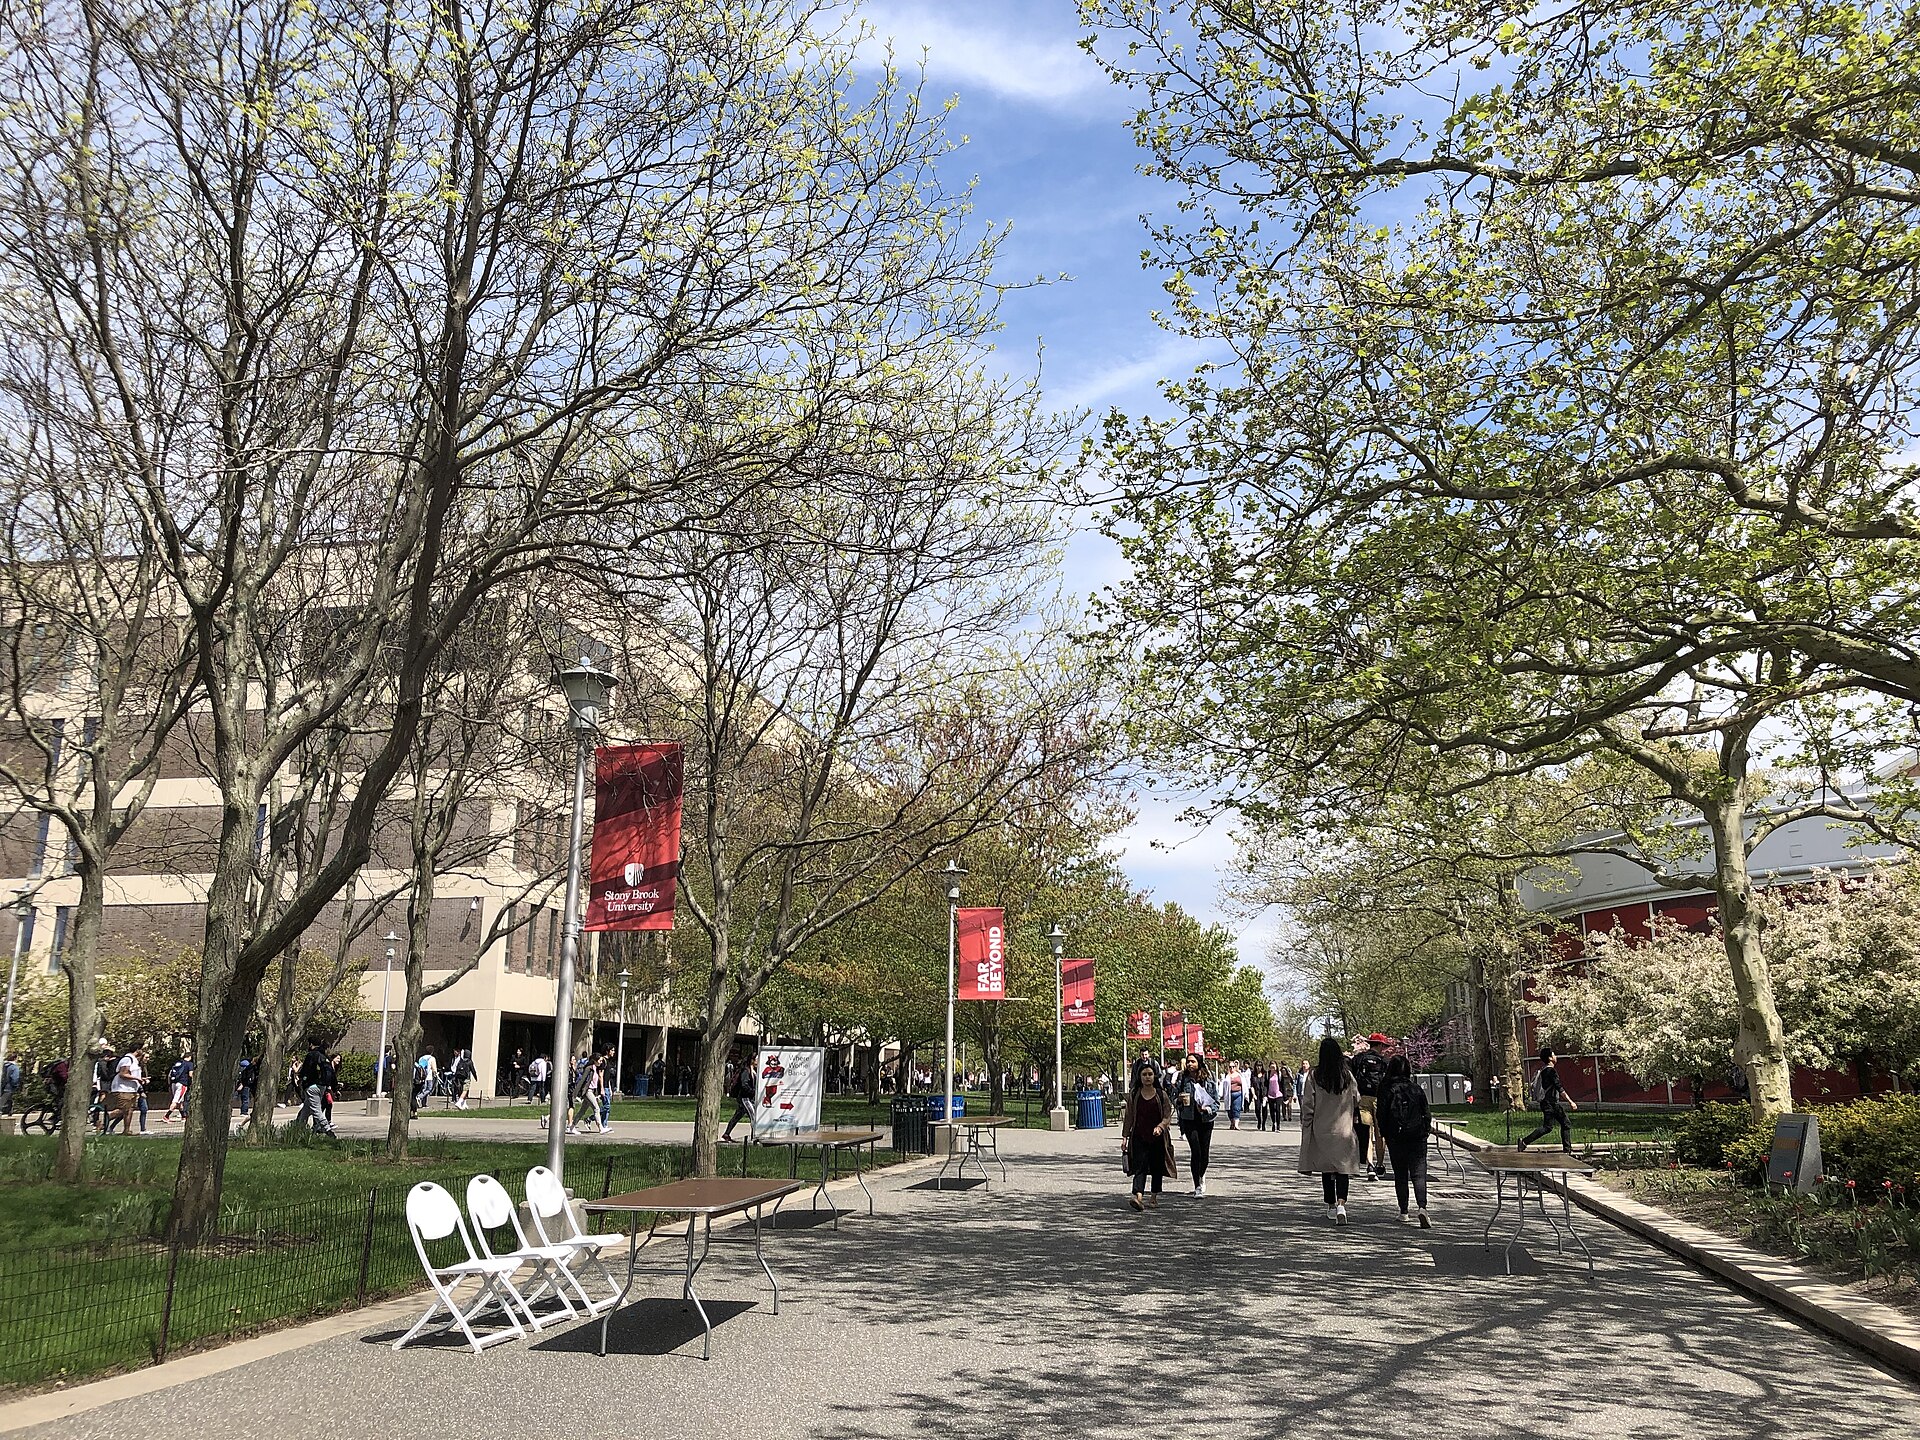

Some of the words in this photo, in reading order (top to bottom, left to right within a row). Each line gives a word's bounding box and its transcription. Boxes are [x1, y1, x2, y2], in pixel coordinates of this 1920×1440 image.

[604, 890, 631, 902] Stony
[632, 888, 660, 900] Brook
[607, 901, 655, 912] University
[989, 926, 1002, 992] BEYOND
[977, 962, 990, 992] FAR
[788, 1054, 810, 1062] Where
[787, 1069, 806, 1077] Banks
